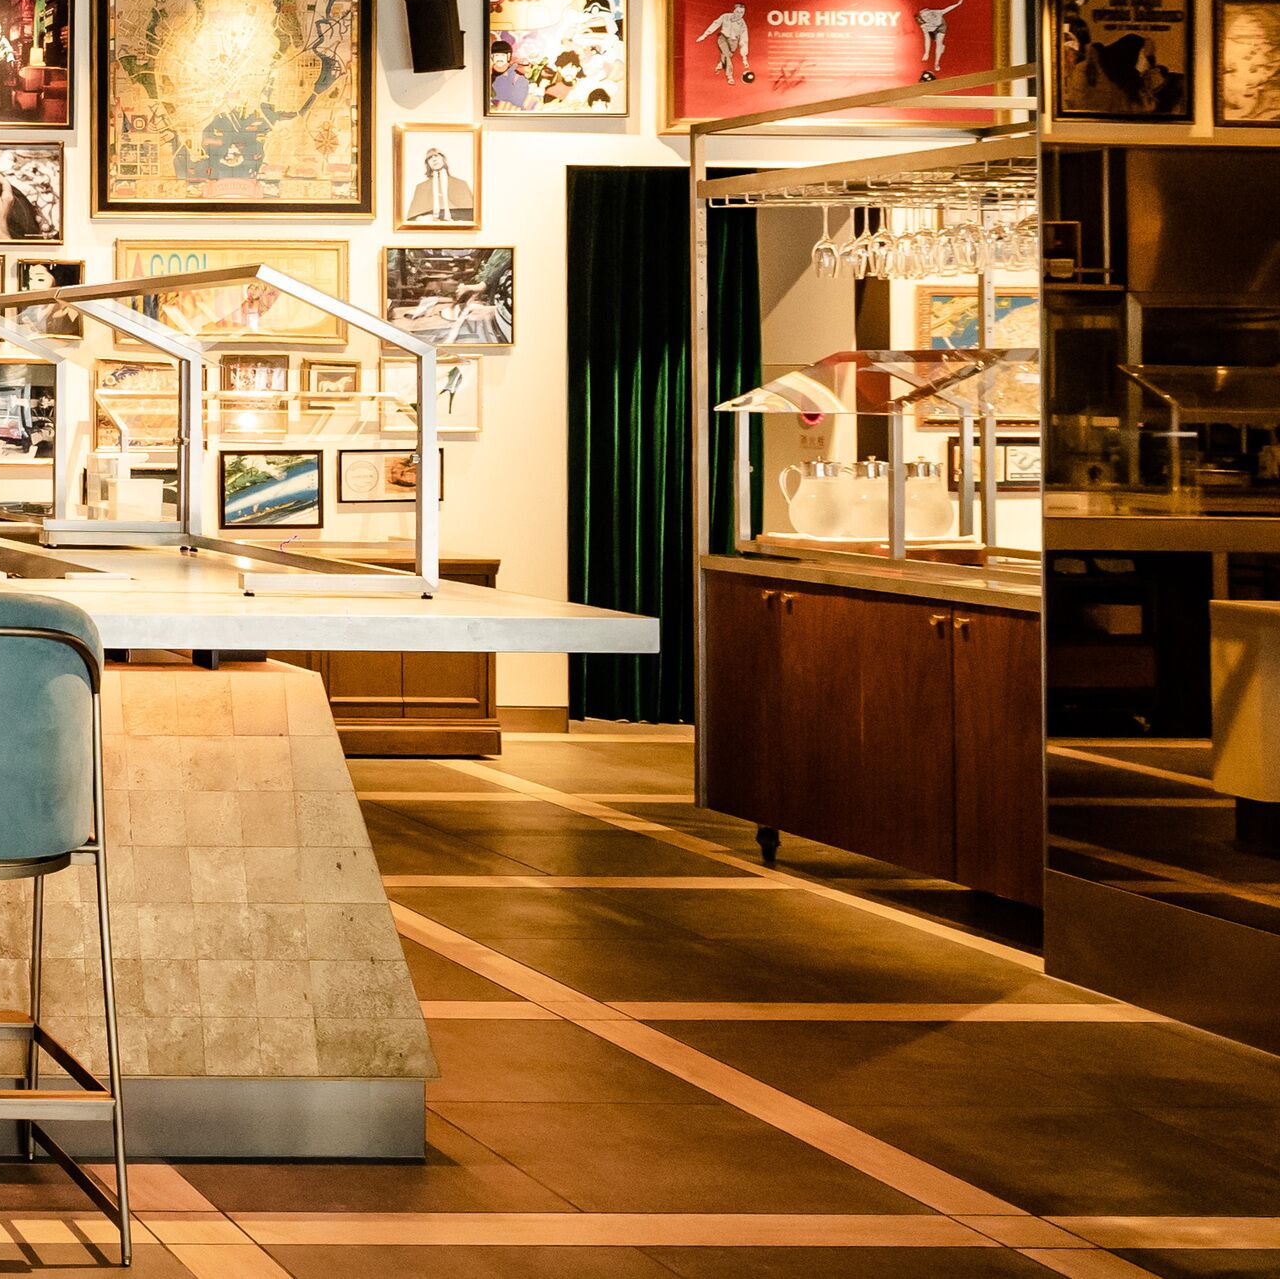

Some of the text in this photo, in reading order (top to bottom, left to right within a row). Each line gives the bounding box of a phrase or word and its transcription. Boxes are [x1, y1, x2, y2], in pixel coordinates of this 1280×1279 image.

[767, 10, 902, 27] OUR HISTORY
[131, 252, 145, 278] A
